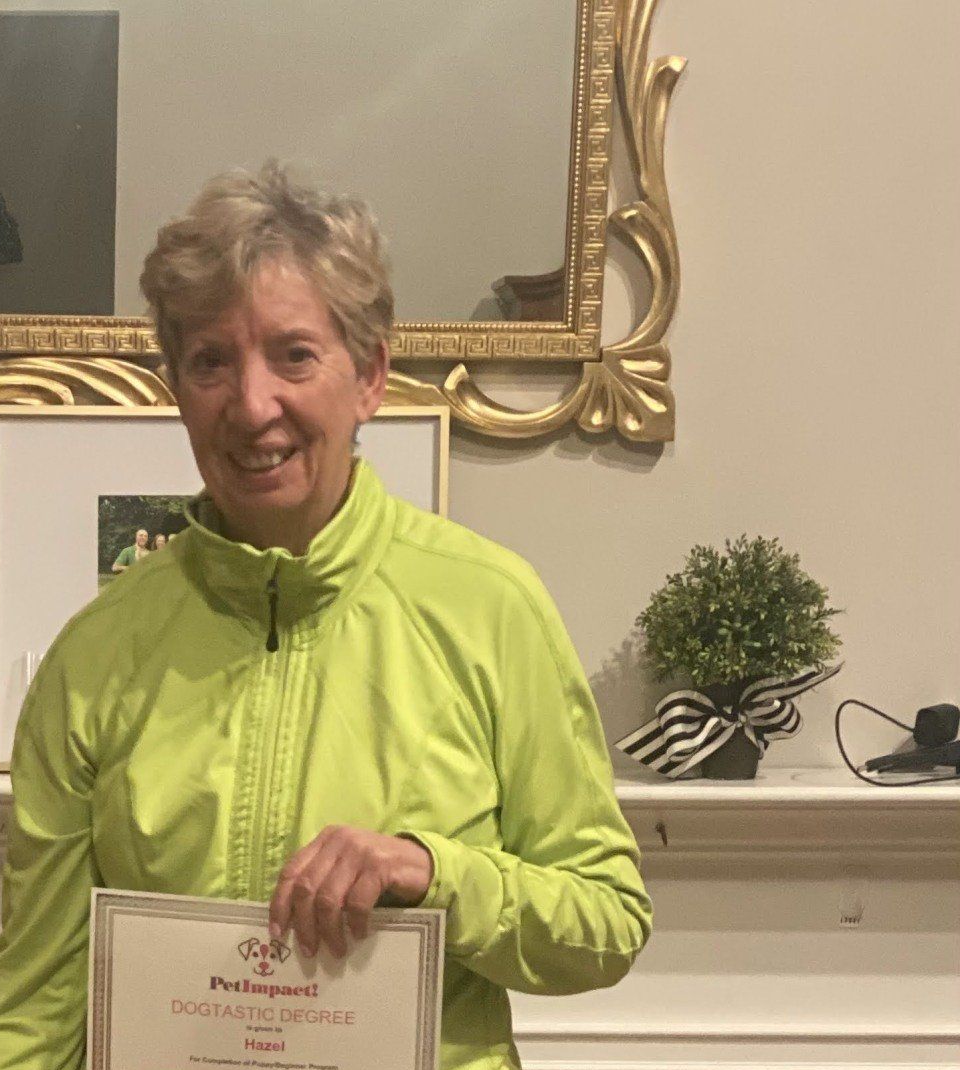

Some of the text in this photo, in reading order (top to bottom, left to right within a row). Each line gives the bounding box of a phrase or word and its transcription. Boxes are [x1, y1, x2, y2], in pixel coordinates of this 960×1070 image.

[210, 976, 319, 998] PetImpact!
[171, 1000, 356, 1026] DOGTASTIC DEGREE
[244, 1038, 285, 1052] Hazel
